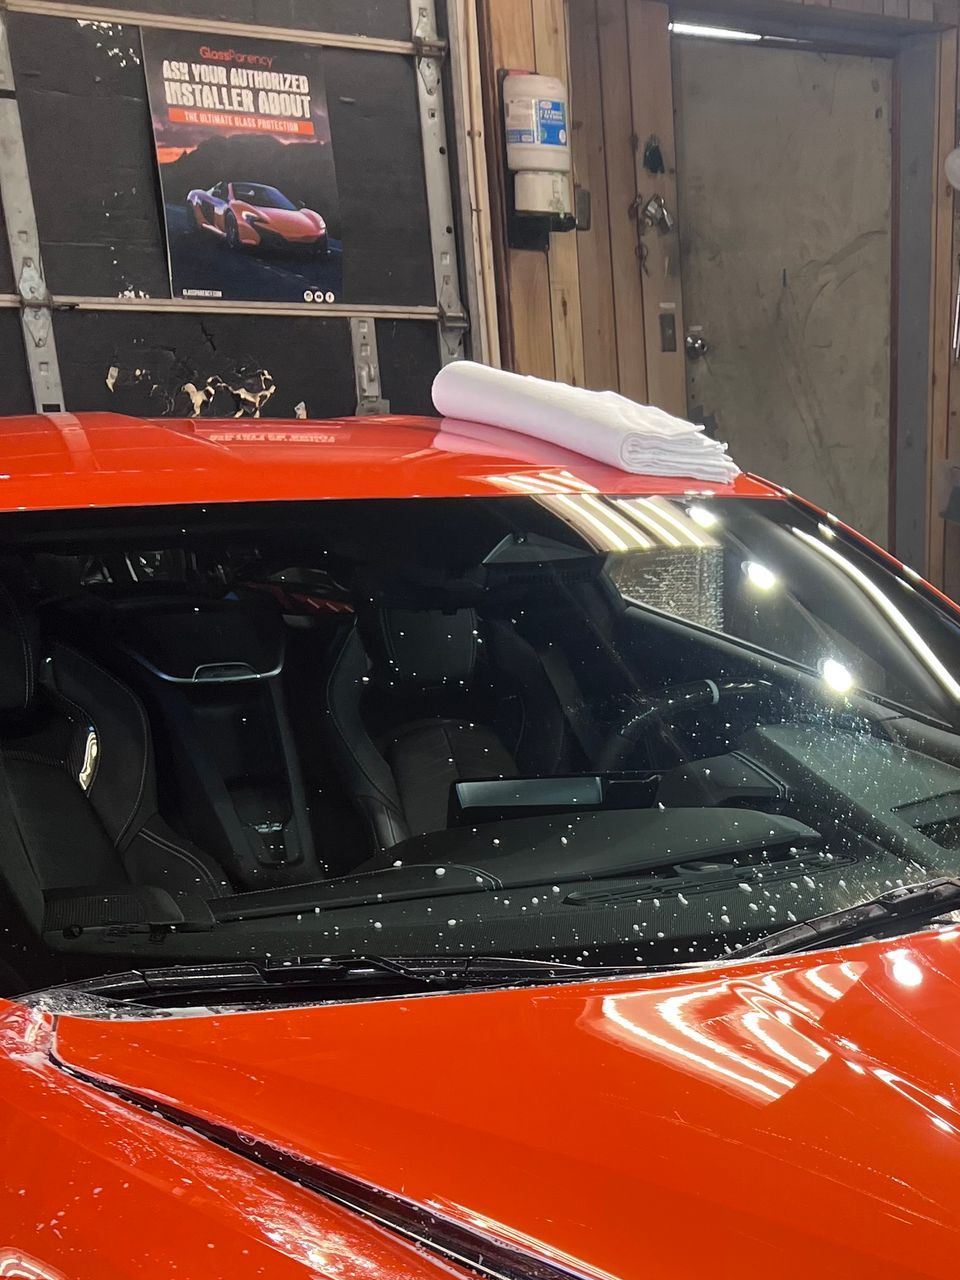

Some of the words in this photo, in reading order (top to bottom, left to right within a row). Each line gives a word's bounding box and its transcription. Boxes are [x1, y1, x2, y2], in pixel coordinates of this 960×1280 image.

[199, 46, 273, 68] GlassParency
[162, 60, 190, 81] ASK
[191, 63, 228, 85] YOUR
[230, 67, 309, 94] AUTHORIZED
[164, 81, 255, 113] INSTALLER
[258, 91, 311, 118] ABOUT
[184, 111, 198, 122] THE
[200, 112, 232, 126] ULTIMATE
[235, 117, 256, 128] GLASS
[257, 119, 299, 132] PROTECTION
